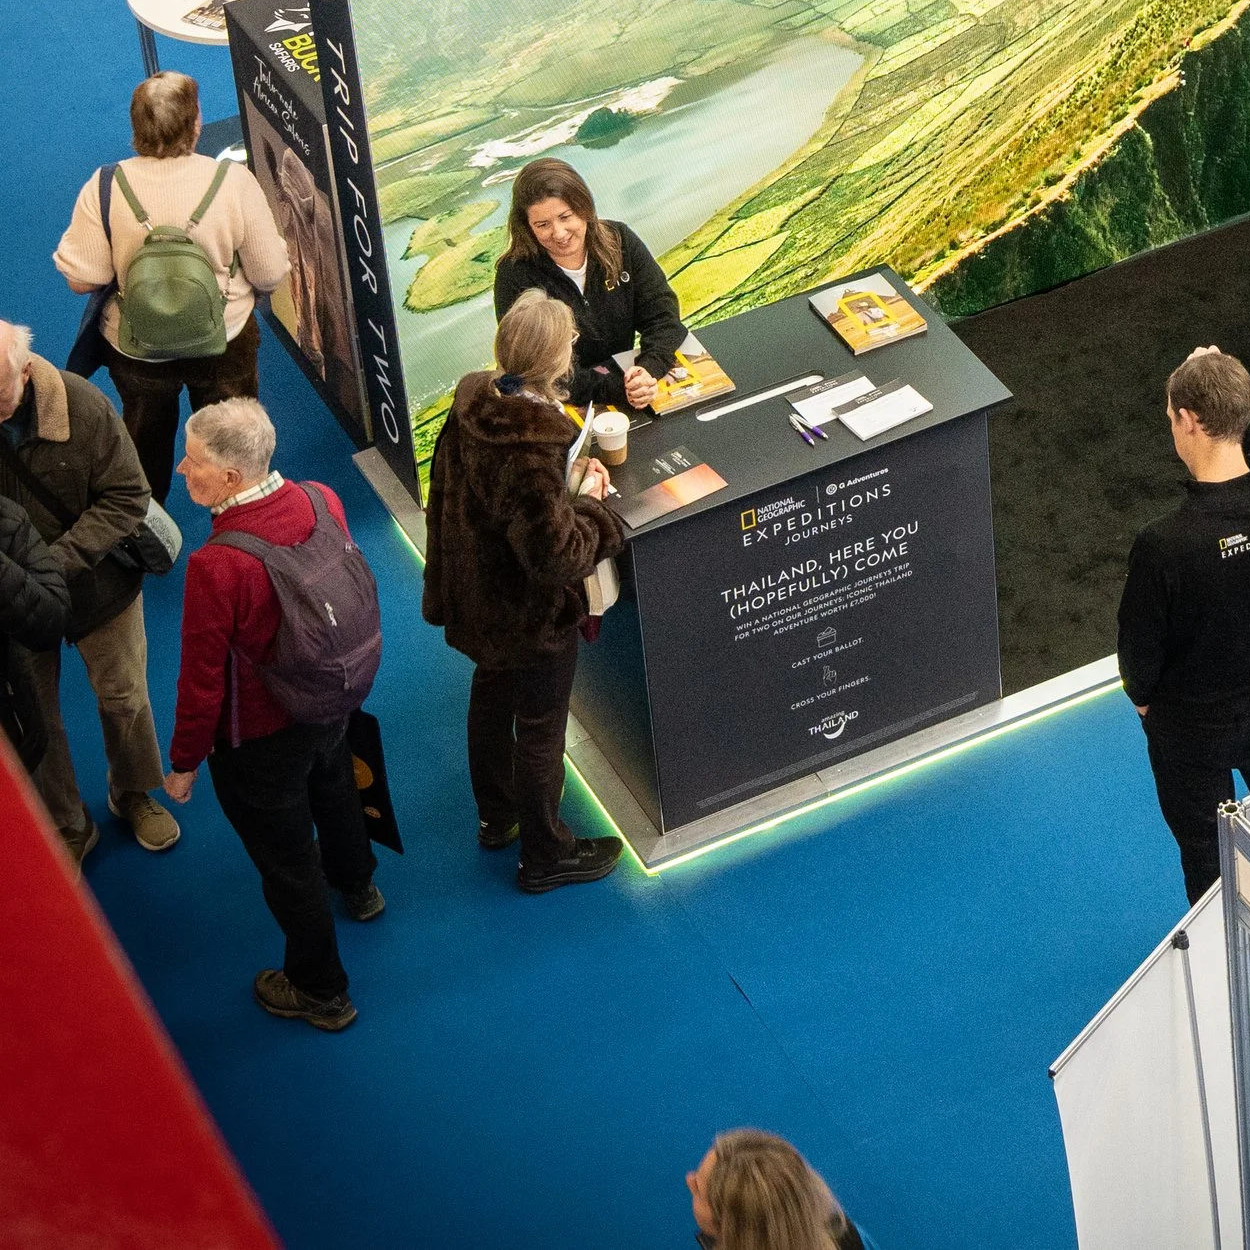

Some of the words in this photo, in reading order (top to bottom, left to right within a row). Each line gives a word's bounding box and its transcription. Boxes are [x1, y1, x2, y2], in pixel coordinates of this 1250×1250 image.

[269, 42, 301, 73] SAFARIS
[326, 37, 359, 164] TRIP
[347, 177, 378, 295] FOR
[368, 317, 400, 444] TWO
[846, 467, 889, 486] Adventures
[742, 483, 891, 548] EXPEDITIONS
[757, 496, 795, 516] NATIONAL
[757, 500, 806, 523] GEOGRAPHIC
[784, 514, 853, 546] JOURNEYS
[721, 559, 823, 603] THAILAND,
[829, 537, 875, 565] HERE
[882, 520, 919, 544] YOU
[730, 564, 848, 619] (HOPEFULLY)
[855, 542, 909, 572] COME
[736, 621, 752, 632] WIN
[761, 603, 801, 623] NATIONAL
[803, 584, 851, 607] GEOGRAPHIC
[853, 570, 892, 587] JOURNEYS
[893, 562, 910, 573] TRIP
[734, 631, 750, 642] FOR
[751, 624, 770, 635] TWO
[772, 618, 784, 628] ON
[785, 611, 802, 623] OUR
[846, 586, 873, 599] ICONIC
[875, 570, 913, 589] THAILAND
[773, 615, 818, 636] ADVENTURE
[820, 603, 848, 617] WORTH
[850, 593, 877, 608] £7,000!
[791, 656, 811, 669] CAST
[812, 648, 833, 662] YOUR
[835, 638, 864, 653] BALLOT.
[790, 696, 815, 710] CROSS
[816, 687, 837, 701] YOUR
[838, 676, 872, 692] FINGERS.
[808, 710, 859, 736] THAILAND
[821, 710, 845, 723] amazing
